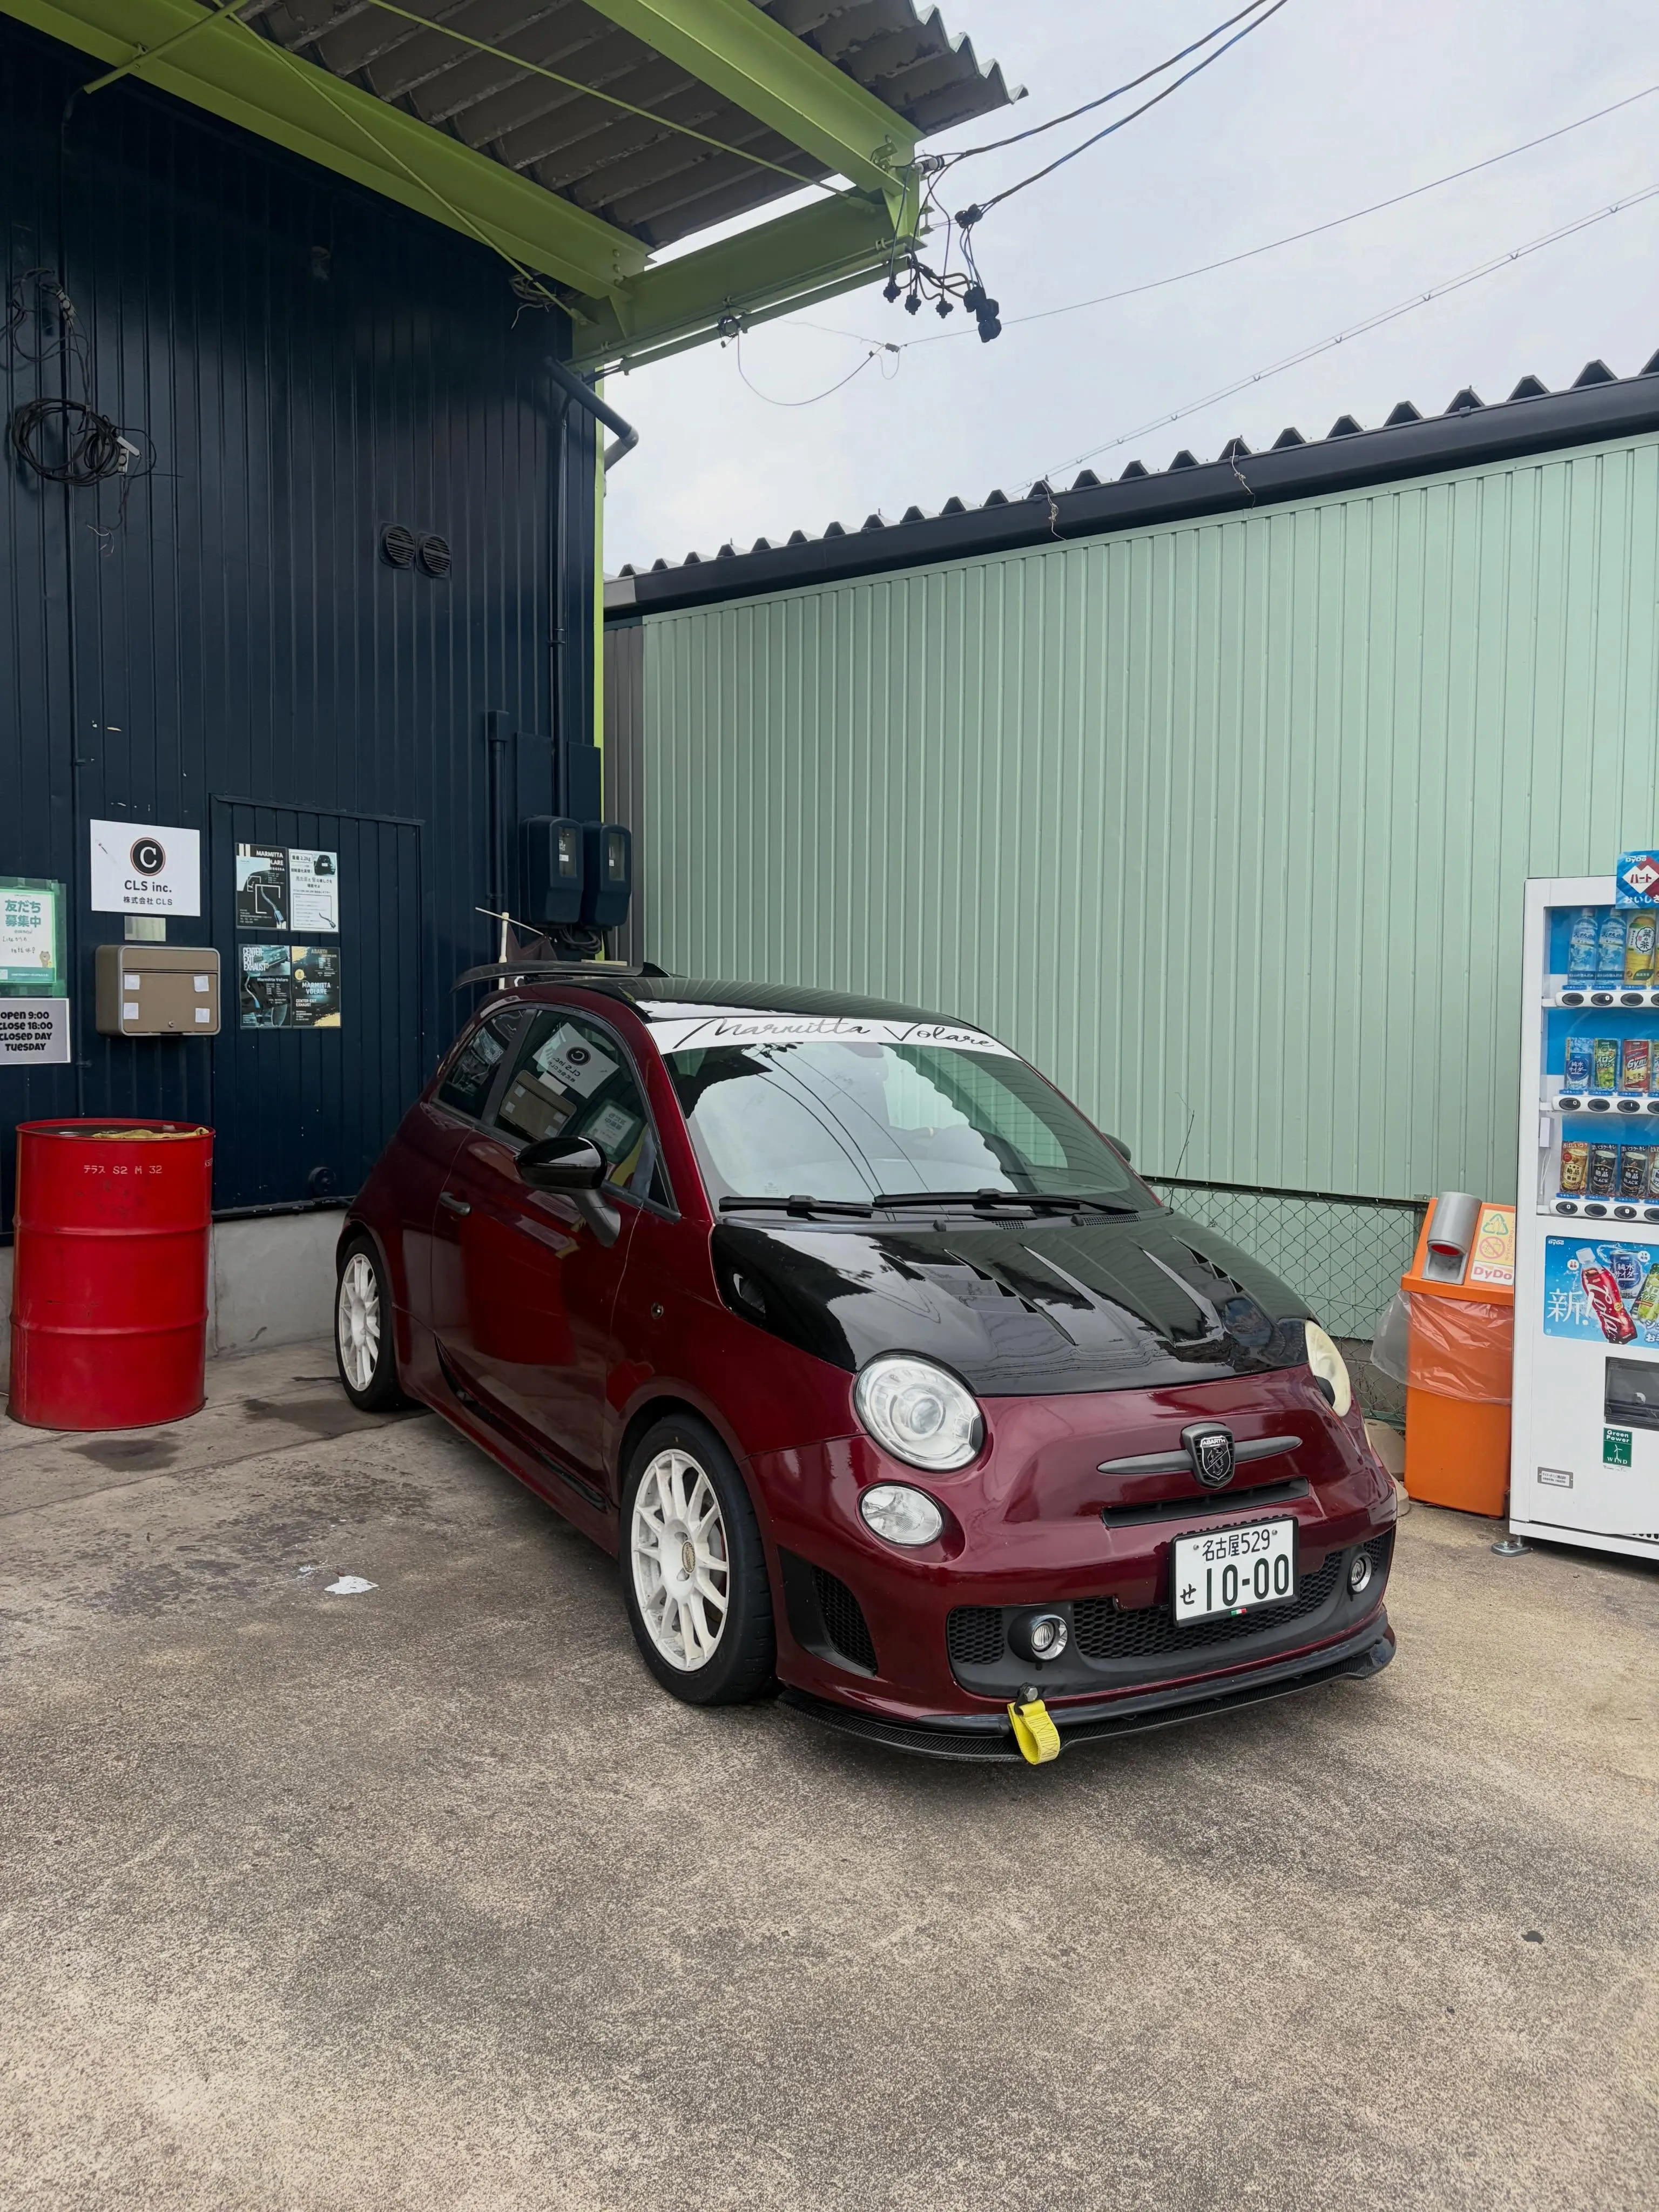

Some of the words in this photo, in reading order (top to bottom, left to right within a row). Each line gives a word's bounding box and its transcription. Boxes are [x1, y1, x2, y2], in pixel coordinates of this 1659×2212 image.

[140, 846, 157, 868] C
[256, 850, 283, 858] MARMITTA
[1630, 874, 1651, 883] ハート
[124, 880, 147, 891] CLS
[152, 882, 172, 893] inc.
[124, 896, 153, 905] 株式会社
[5, 899, 41, 914] 友だち
[5, 914, 42, 928] 募集中
[243, 947, 262, 956] CENTER
[244, 955, 254, 964] EXIT
[35, 1032, 52, 1040] DAY
[673, 1018, 871, 1049] Marmitta
[882, 1022, 995, 1048] Volare
[84, 1165, 105, 1174] テラス
[134, 1166, 142, 1174] M
[149, 1165, 162, 1174] 32
[1473, 1266, 1513, 1279] DyDo
[1616, 1271, 1638, 1279] サイダー
[1607, 1429, 1629, 1438] Green
[1202, 1437, 1226, 1446] ABARTH
[1606, 1434, 1630, 1443] Power
[1607, 1456, 1628, 1465] WIND
[1180, 1583, 1197, 1605] せ
[1206, 1554, 1289, 1611] 10-00
